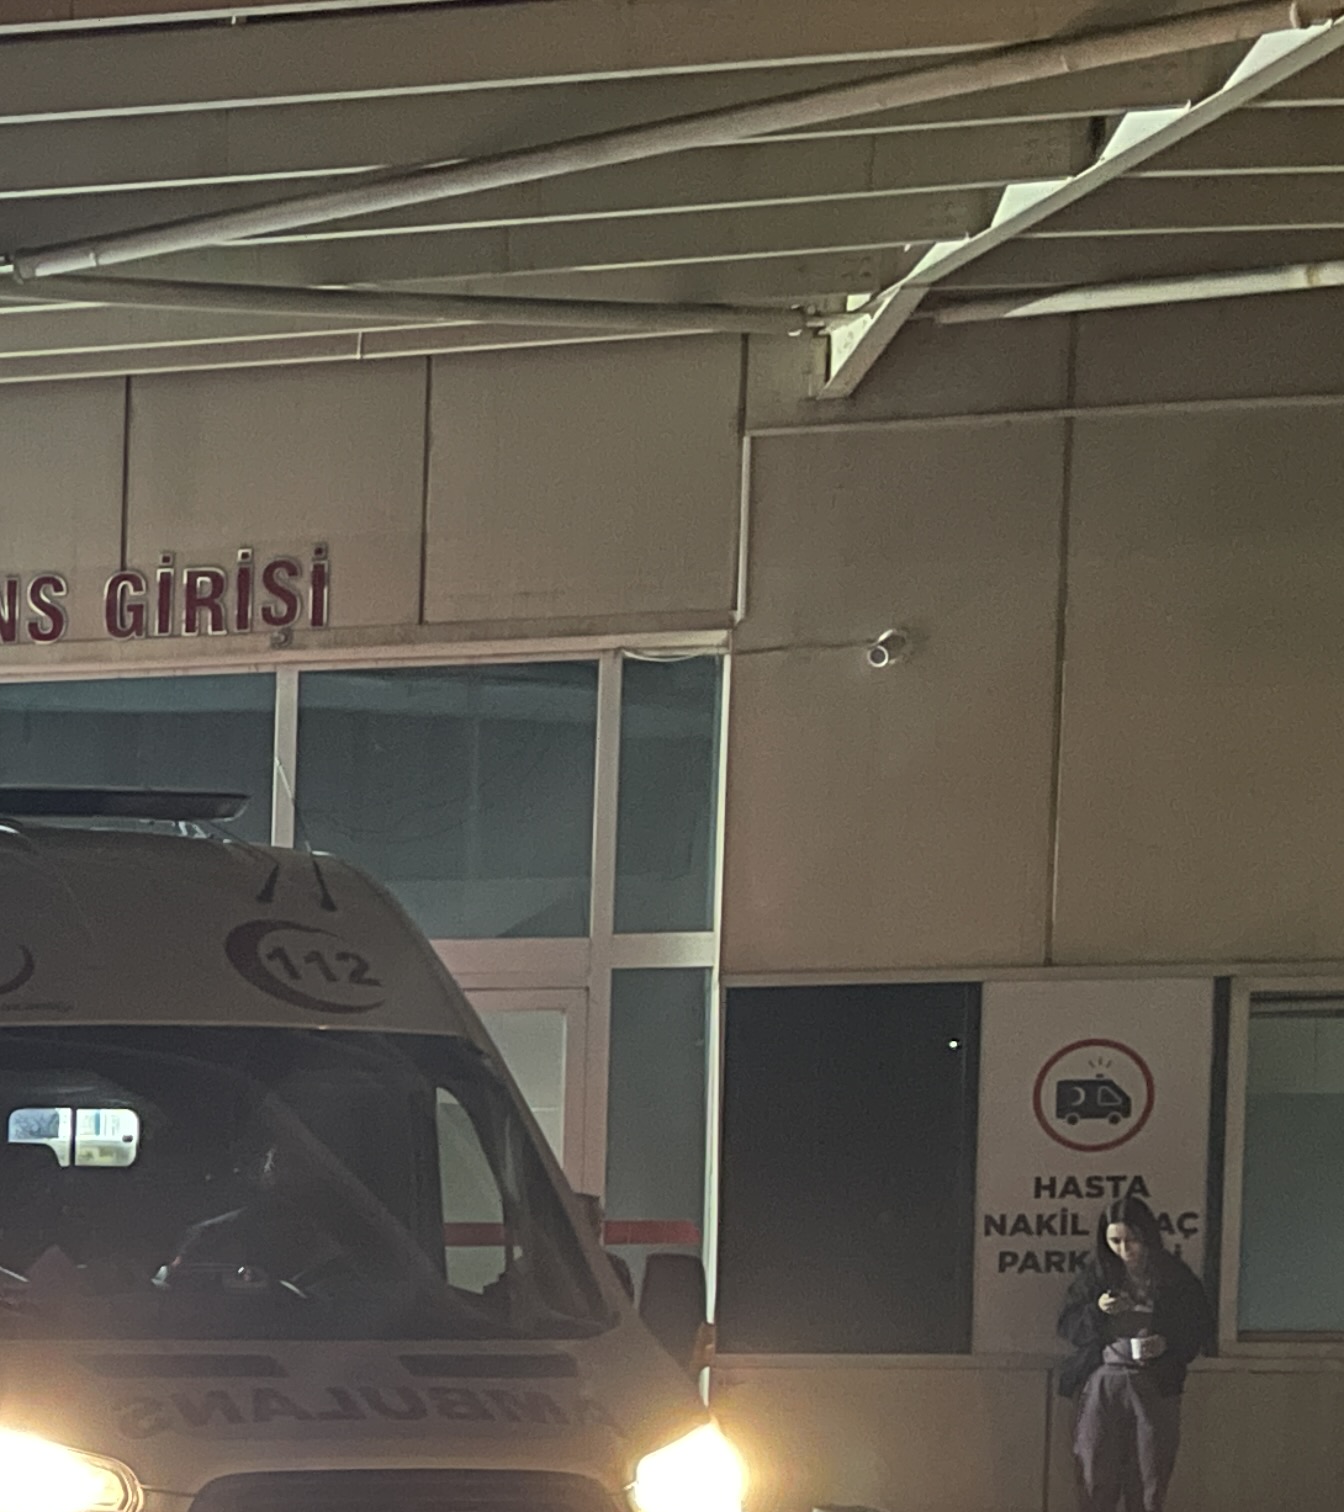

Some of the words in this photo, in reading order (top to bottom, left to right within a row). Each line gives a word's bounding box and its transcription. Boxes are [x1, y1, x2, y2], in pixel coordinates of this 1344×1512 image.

[105, 543, 329, 648] GİRİŞİ
[266, 946, 382, 987] 112
[1034, 1175, 1151, 1199] HASTA
[983, 1207, 1089, 1237] NAKİL
[998, 1250, 1090, 1274] PARK
